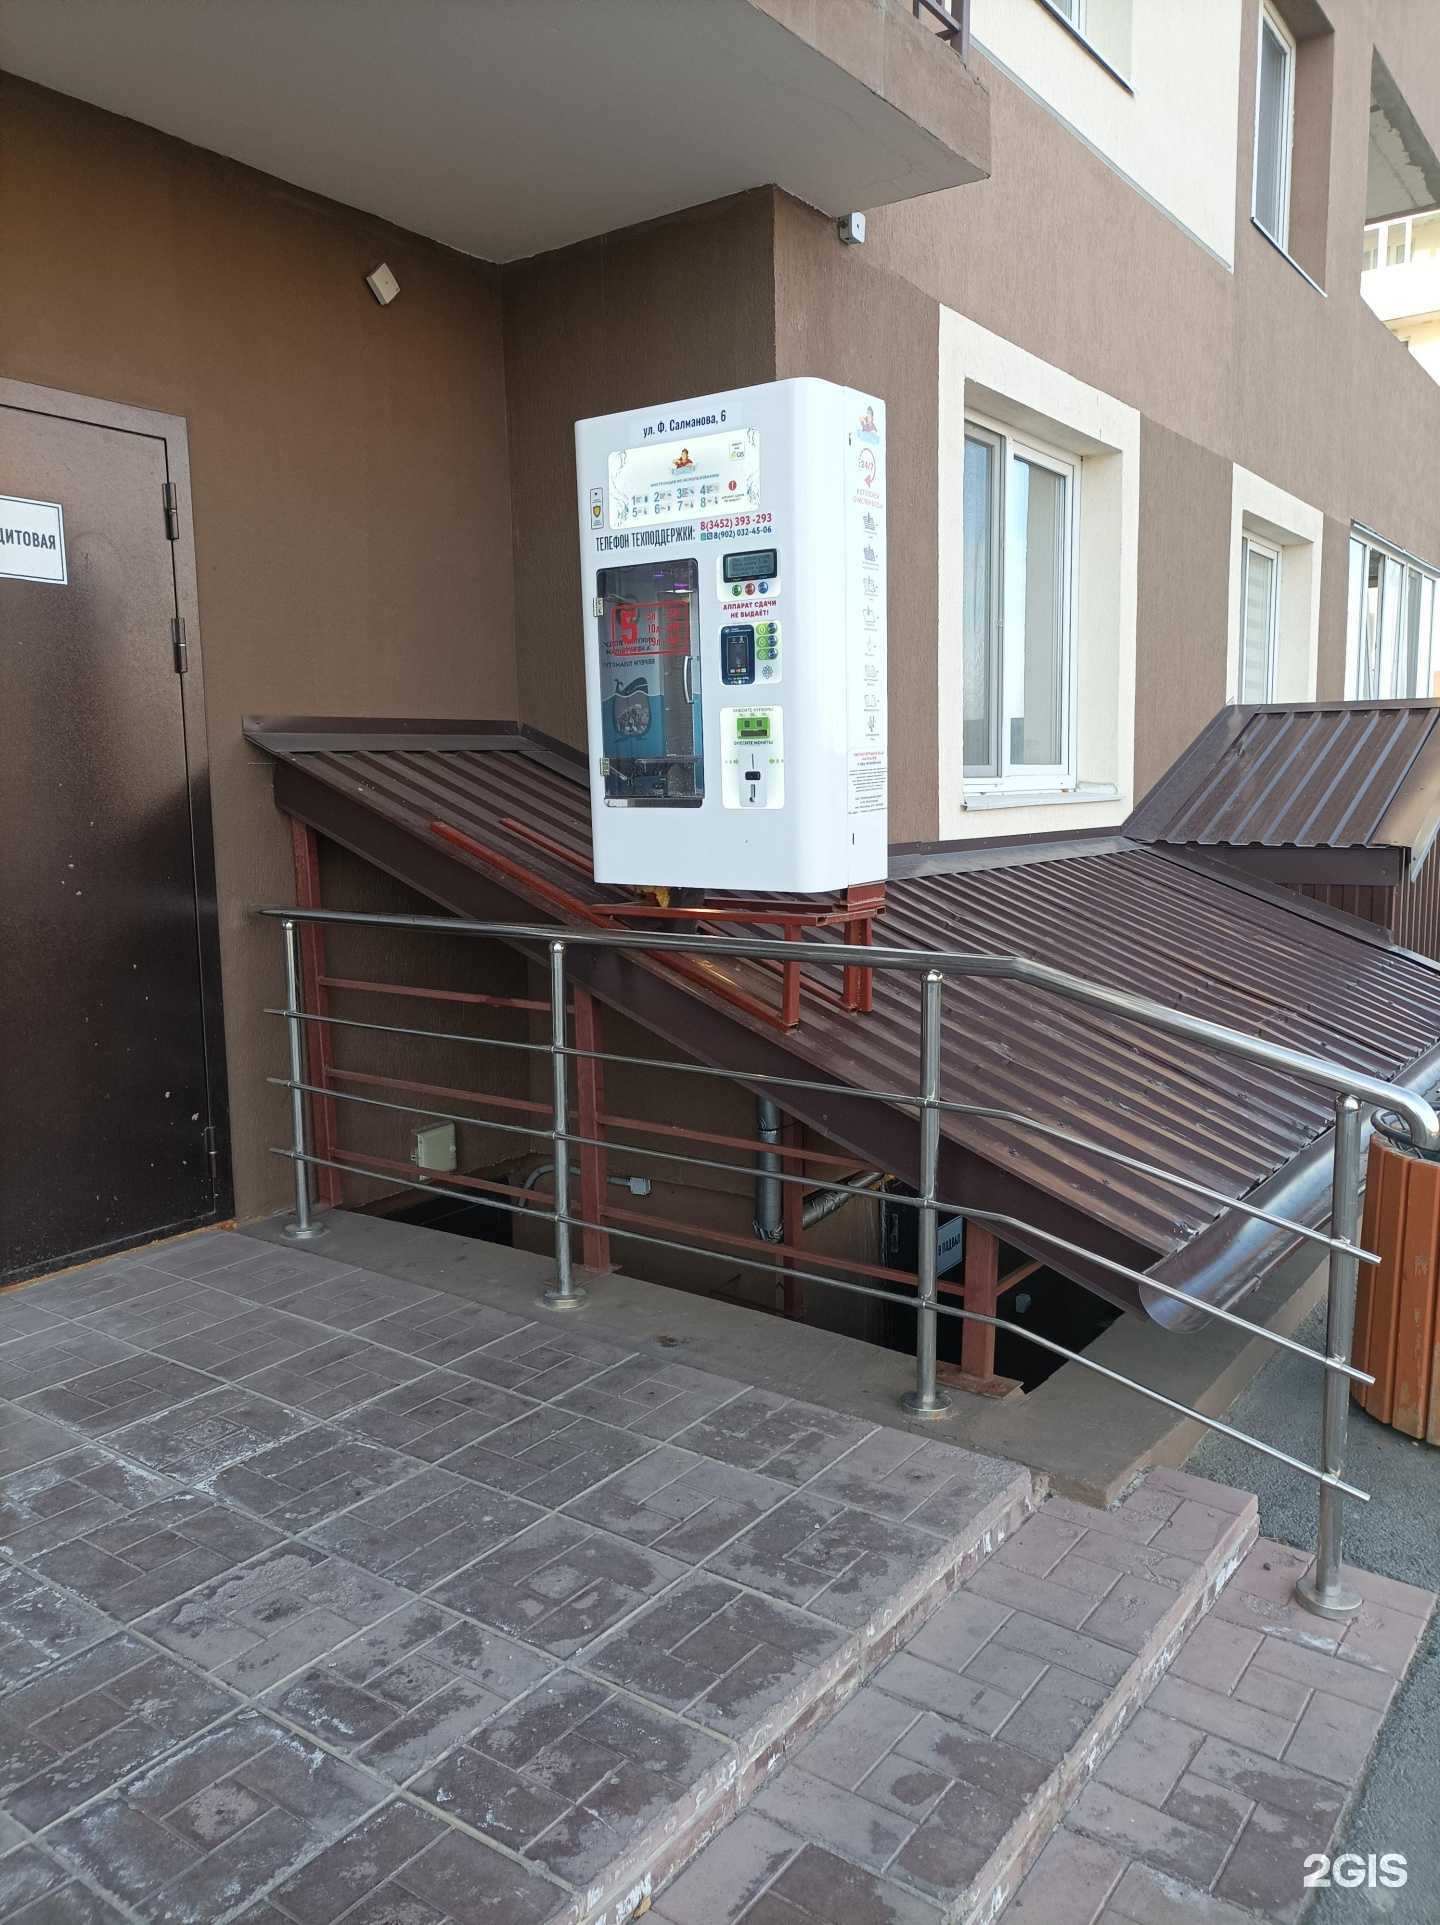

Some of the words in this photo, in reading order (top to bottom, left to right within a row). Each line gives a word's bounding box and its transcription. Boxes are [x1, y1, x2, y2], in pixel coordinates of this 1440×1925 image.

[643, 426, 655, 438] ул.
[657, 421, 667, 433] Ф.
[669, 414, 718, 431] Салманова,
[720, 409, 726, 422] 6
[700, 518, 733, 531] 8(3452)
[595, 533, 630, 552] ТЕЛЕФОН
[631, 525, 696, 548] ТЕХПОДДЕРЖКИ:
[723, 602, 753, 611] АППАРАТ
[754, 600, 777, 609] СДАЧИ
